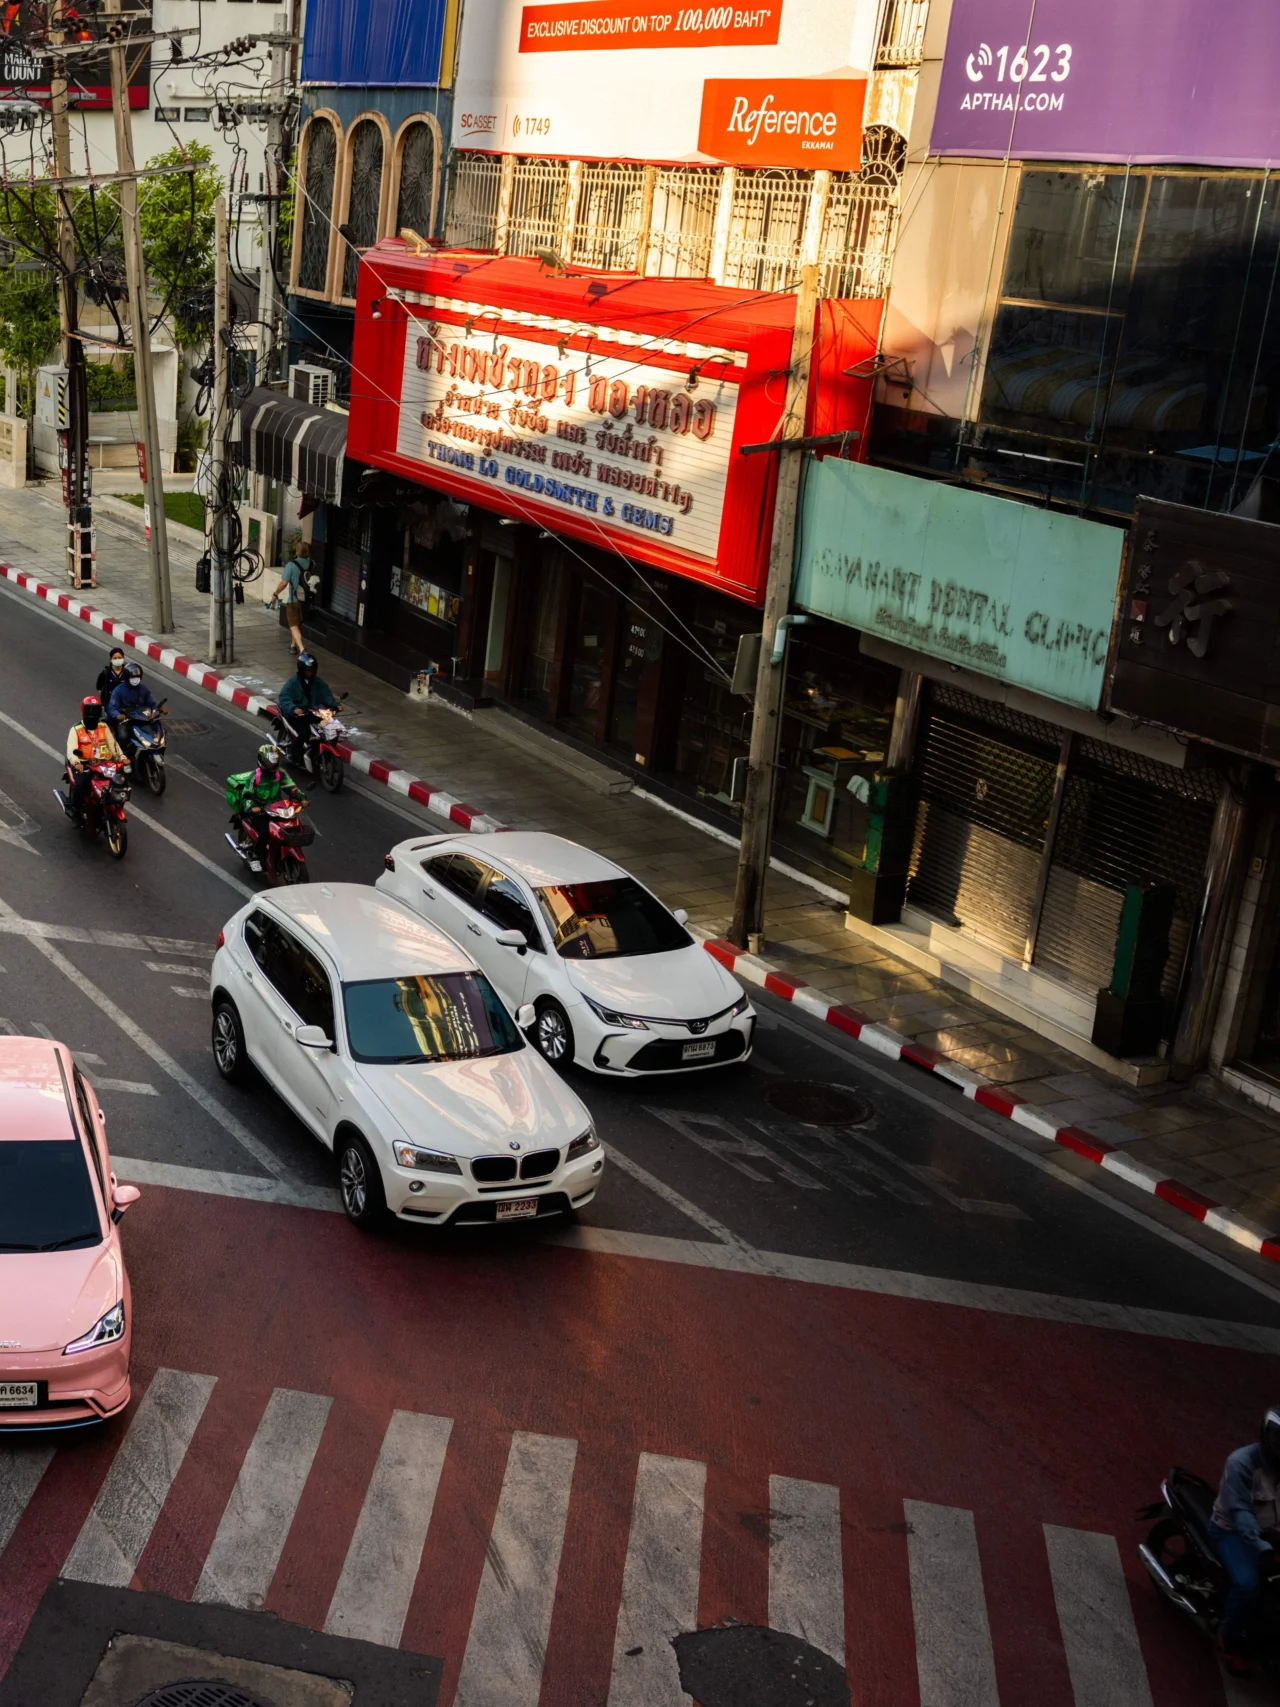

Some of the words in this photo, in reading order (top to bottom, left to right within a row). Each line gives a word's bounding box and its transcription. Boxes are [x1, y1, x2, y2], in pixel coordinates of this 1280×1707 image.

[527, 20, 579, 37] EXCLUSIVE
[580, 17, 631, 35] DISCOUNT
[632, 16, 648, 33] ON
[650, 14, 672, 32] TOP
[674, 7, 732, 34] 100,000
[4, 52, 31, 65] MAKE
[4, 64, 44, 80] COUNT
[996, 43, 1073, 82] 1623
[460, 114, 474, 128] SC
[473, 115, 496, 130] ASSET
[524, 117, 551, 136] 1749
[727, 94, 836, 145] Reference
[801, 140, 834, 150] EKKAMAI
[416, 321, 577, 407] ห้างเพชรทอง
[556, 419, 588, 445] และ
[596, 419, 664, 466] รับสั่งทำ
[427, 440, 474, 470] THONG
[478, 456, 498, 478] LO
[504, 465, 598, 512] GOLDSMITH
[603, 496, 614, 516] &
[621, 502, 674, 536] GEMS
[551, 450, 592, 478] เพชร
[596, 468, 693, 514] พลอยต่างๆ
[1024, 610, 1108, 666] CLINIC
[514, 1200, 536, 1212] 2233
[9, 1386, 34, 1395] 6634
